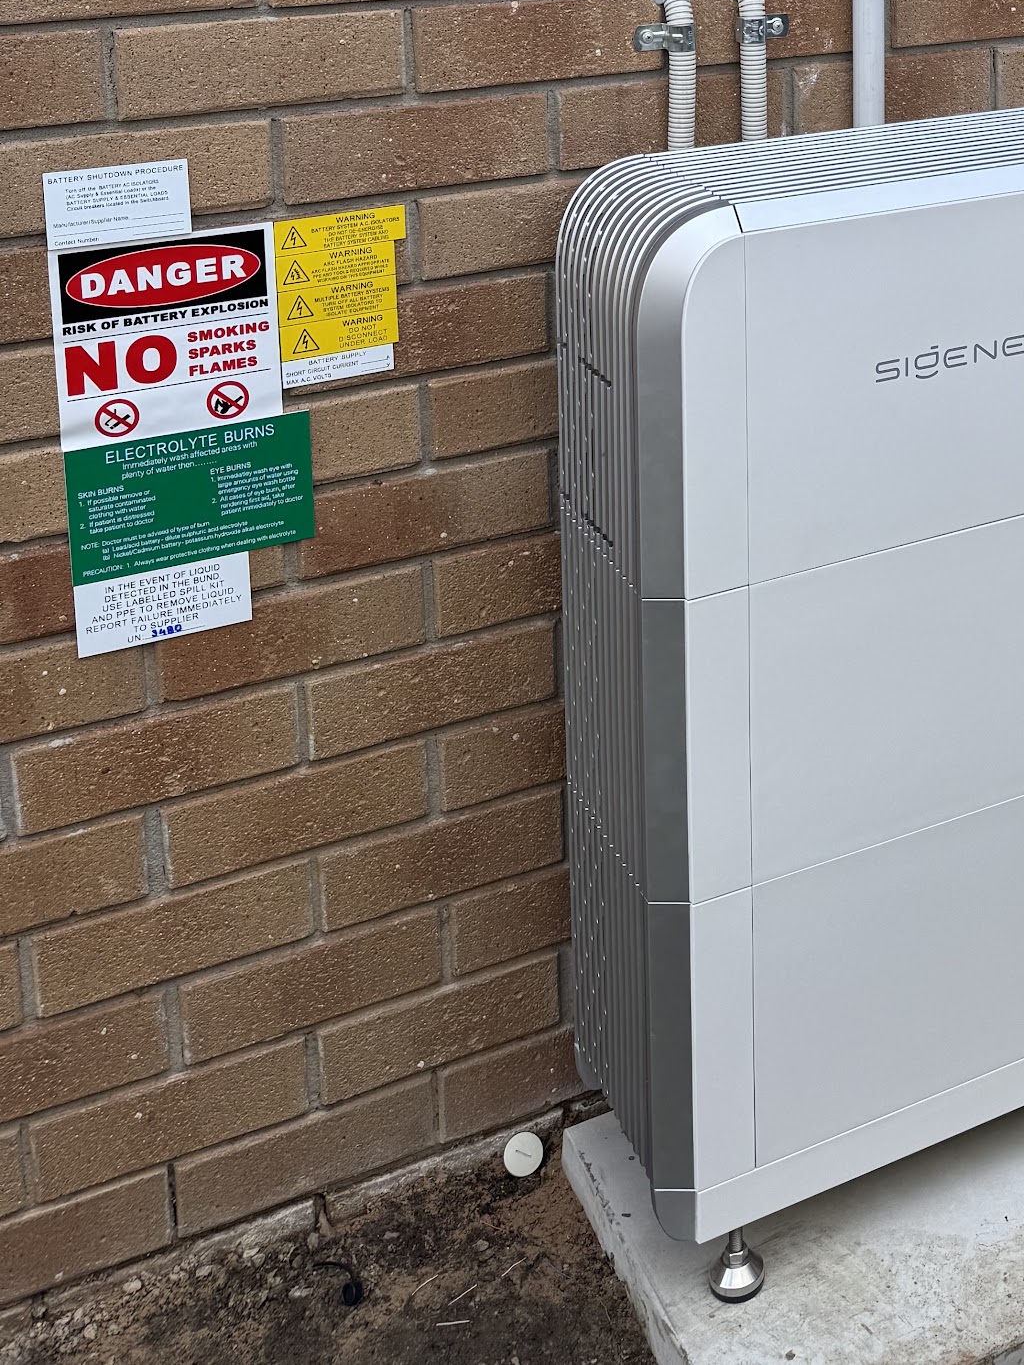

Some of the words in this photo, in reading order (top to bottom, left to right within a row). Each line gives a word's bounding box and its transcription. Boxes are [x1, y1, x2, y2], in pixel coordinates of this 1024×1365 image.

[47, 175, 83, 184] BATTERY
[87, 170, 132, 180] SHUTDOWN
[135, 164, 182, 175] PROCEDURE
[311, 225, 334, 233] BATTERY
[370, 216, 399, 224] ISOLATORS
[336, 212, 375, 223] WARNING
[329, 246, 372, 259] WARNING
[80, 254, 246, 299] DANGER
[314, 294, 338, 302] MULTIPLE
[340, 290, 363, 298] BATTERY
[365, 286, 389, 294] SYSTEMS
[330, 281, 373, 293] WARNING
[63, 323, 96, 336] RISK
[101, 320, 120, 330] OF
[124, 310, 188, 327] BATTERY
[192, 299, 268, 317] EXPLOSION
[342, 314, 382, 327] WARNING
[188, 321, 270, 342] SMOKING
[338, 328, 387, 342] DSCONNECT
[188, 340, 256, 360] SPARKS
[339, 339, 365, 348] UNDER
[64, 335, 178, 396] NO
[189, 356, 258, 376] FLAMES
[308, 356, 338, 365] BATTERY
[341, 350, 366, 359] SUPPLY
[307, 365, 330, 373] CIRCUIT
[332, 360, 358, 369] CURRENT
[312, 372, 331, 380] VOLTS
[105, 433, 217, 464] ELECTROLYTE
[224, 423, 274, 443] BURNS
[122, 456, 168, 471] Immediately
[169, 452, 188, 462] wash
[189, 446, 220, 458] affected
[221, 444, 240, 453] areas
[242, 440, 257, 449] with
[121, 469, 144, 480] plenty
[155, 464, 176, 473] water
[210, 466, 224, 474] EYE
[226, 461, 251, 472] BURNS
[217, 481, 232, 489] large
[233, 476, 258, 485] amounts
[283, 468, 298, 477] using
[77, 490, 95, 499] SKIN
[97, 484, 124, 495] BURNS
[92, 494, 118, 505] possible
[119, 491, 142, 499] remove
[218, 484, 250, 496] emergency
[284, 494, 303, 502] doctor
[88, 503, 113, 512] saturate
[114, 495, 155, 507] contaminated
[220, 498, 248, 509] rendering
[88, 510, 113, 520] clothing
[94, 517, 115, 527] patient
[122, 510, 154, 520] distressed
[104, 523, 125, 532] patient
[134, 517, 153, 525] doctor
[101, 537, 121, 546] Doctor
[147, 528, 168, 537] advised
[176, 524, 188, 532] type
[133, 557, 154, 568] Always
[169, 548, 197, 560] protective
[198, 544, 219, 554] clothing
[236, 537, 255, 547] dealing
[268, 528, 296, 540] electrolyte
[118, 580, 135, 590] THE
[139, 573, 170, 586] EVENT
[173, 570, 185, 579] OF
[189, 563, 220, 576] LIQUID
[102, 601, 122, 612] USE
[126, 590, 176, 607] LABELLED
[179, 584, 205, 595] SPILL
[209, 579, 224, 589] KIT
[104, 585, 156, 603] DETECTED
[159, 583, 168, 591] IN
[172, 578, 189, 588] THE
[86, 618, 127, 634] REPORT
[131, 609, 172, 624] FAILURE
[176, 594, 242, 614] IMMEDIATELY
[91, 612, 112, 623] AND
[116, 608, 135, 618] PPE
[141, 604, 152, 613] TO
[156, 594, 197, 609] REMOVE
[134, 624, 146, 633] TO
[150, 612, 198, 629] SUPPLIER
[151, 623, 181, 637] 3480
